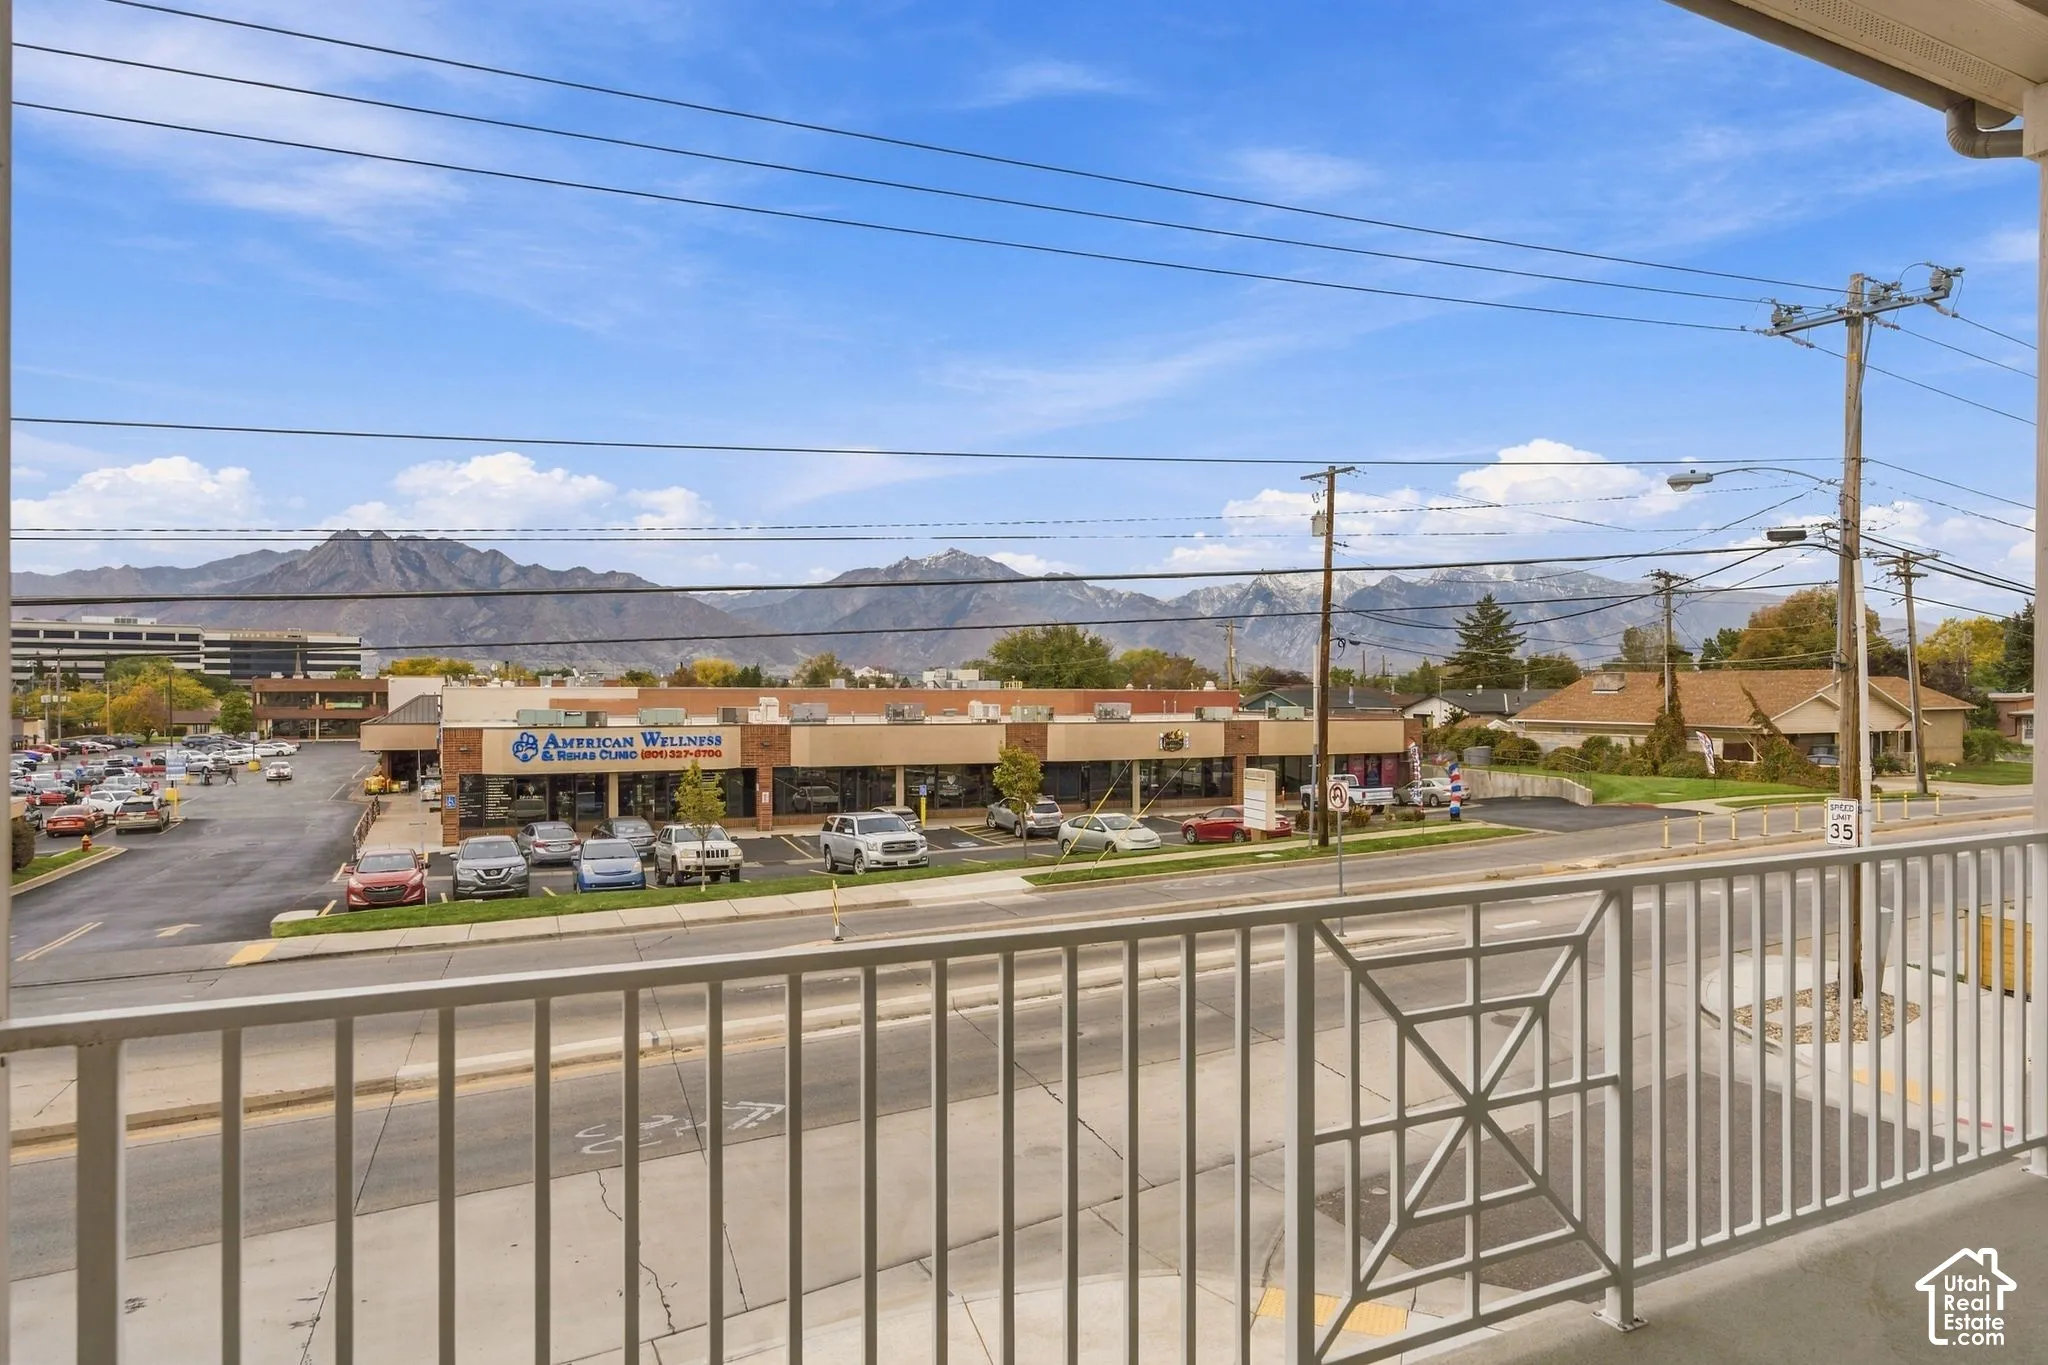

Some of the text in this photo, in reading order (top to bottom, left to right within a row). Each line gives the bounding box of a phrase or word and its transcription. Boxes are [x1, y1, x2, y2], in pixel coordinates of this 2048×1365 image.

[543, 731, 722, 749] AMERICAN WELLNESS
[541, 750, 554, 761] &
[557, 750, 596, 761] REHAB
[599, 749, 638, 760] CLINIC
[1830, 804, 1854, 812] SPEED
[1830, 823, 1853, 840] 35
